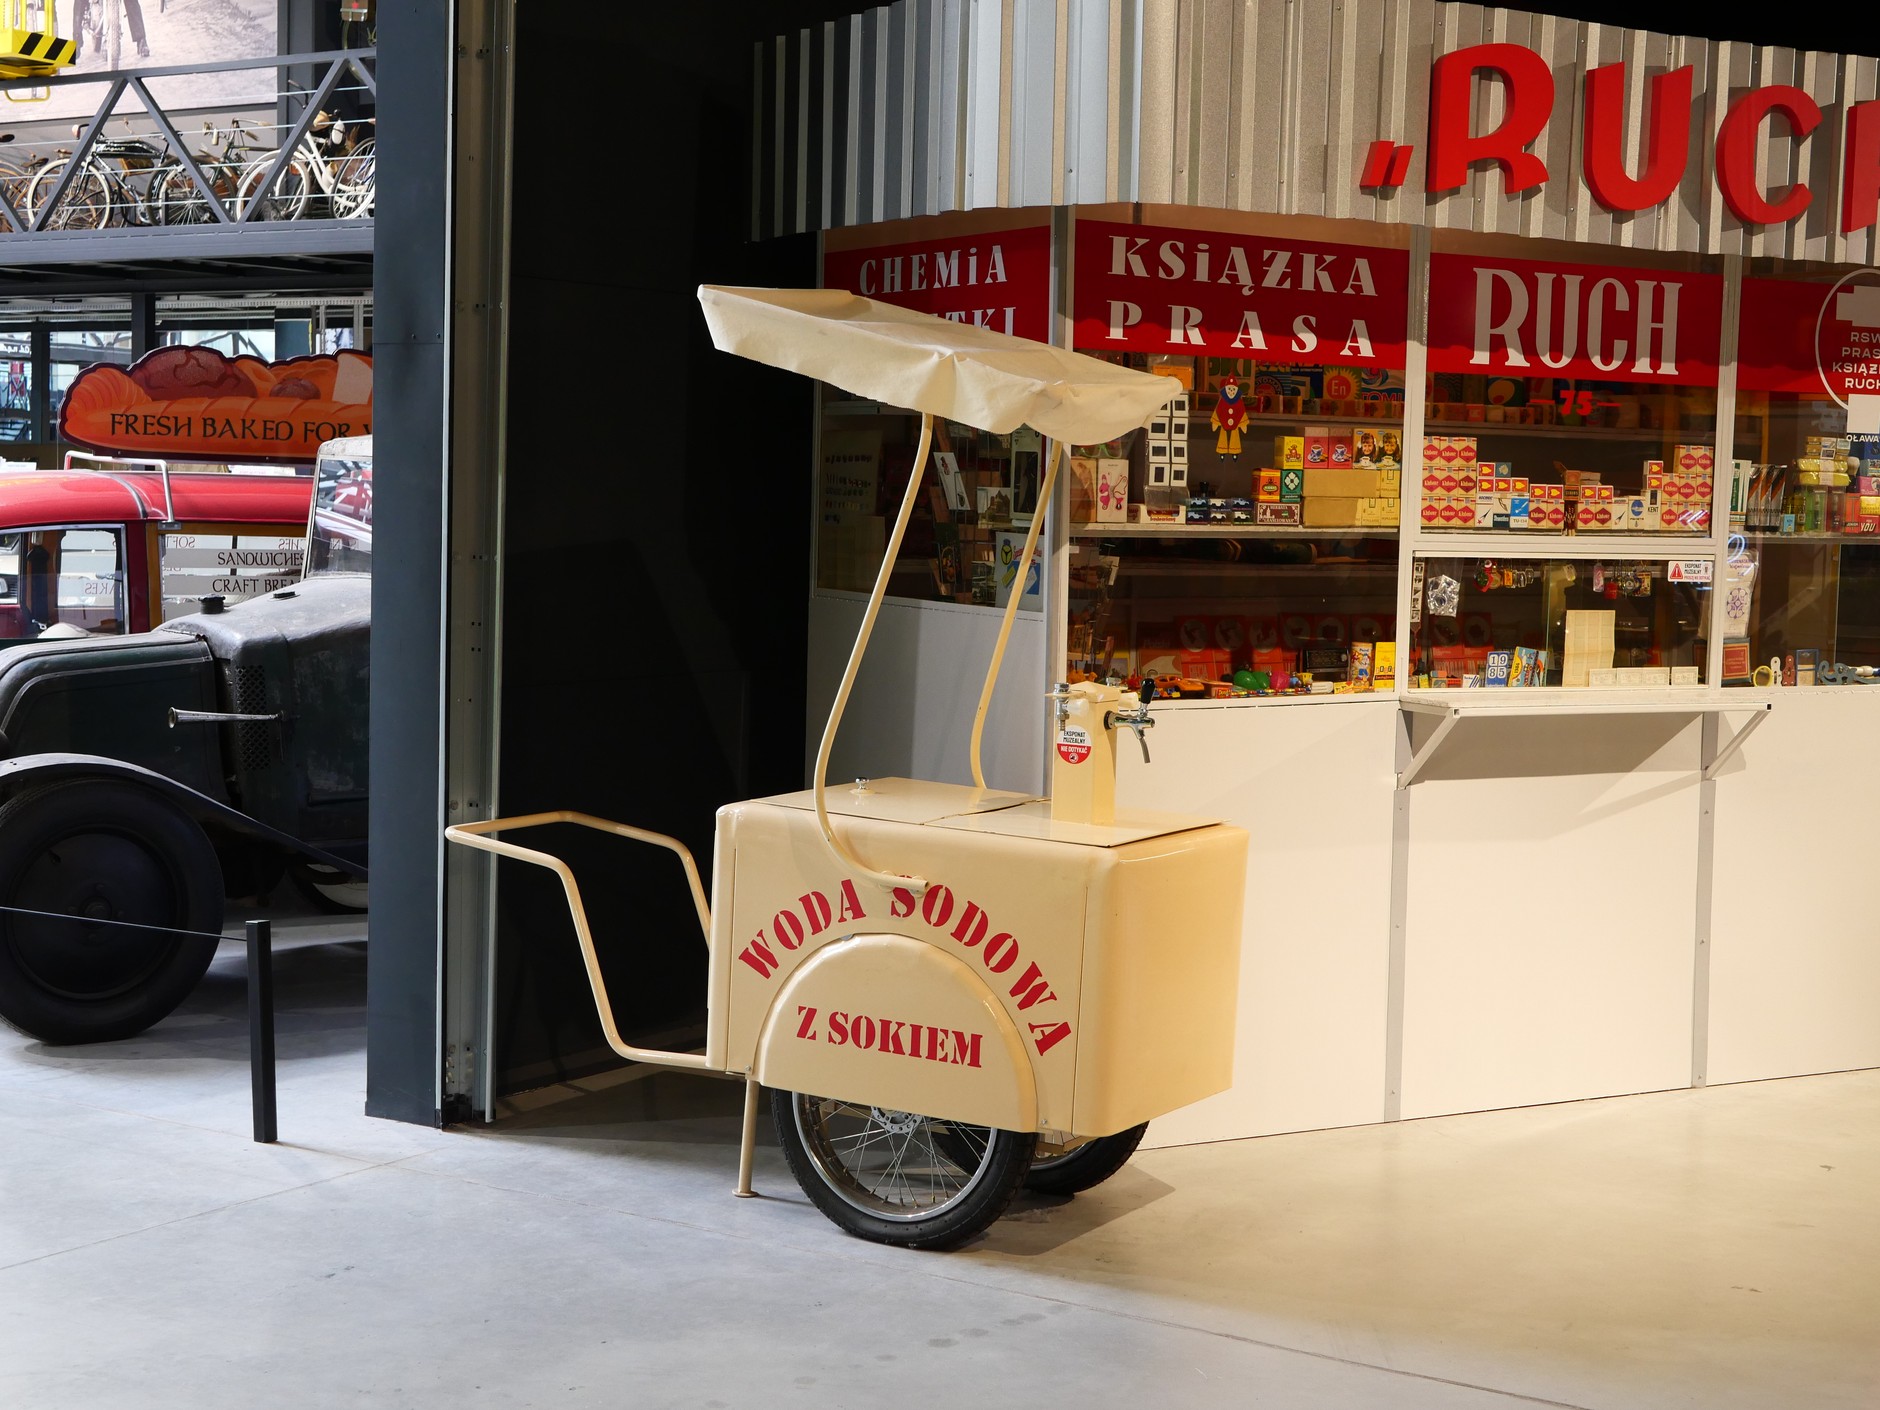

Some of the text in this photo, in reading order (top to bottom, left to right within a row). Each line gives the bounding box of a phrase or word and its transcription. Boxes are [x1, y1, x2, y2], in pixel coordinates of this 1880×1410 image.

[1105, 300, 1376, 357] PRASA
[1469, 267, 1683, 376] RUCH
[1832, 362, 1880, 377] KSIĄŻ
[1560, 390, 1593, 416] 75
[110, 413, 192, 437] FRESH
[202, 417, 293, 441] BAKED
[303, 421, 351, 443] FOR
[1861, 523, 1876, 532] YOU
[212, 579, 302, 594] CRAFT BRE
[738, 875, 1071, 1056] WODA SODOWA
[796, 1005, 983, 1068] Z SOKIEM
